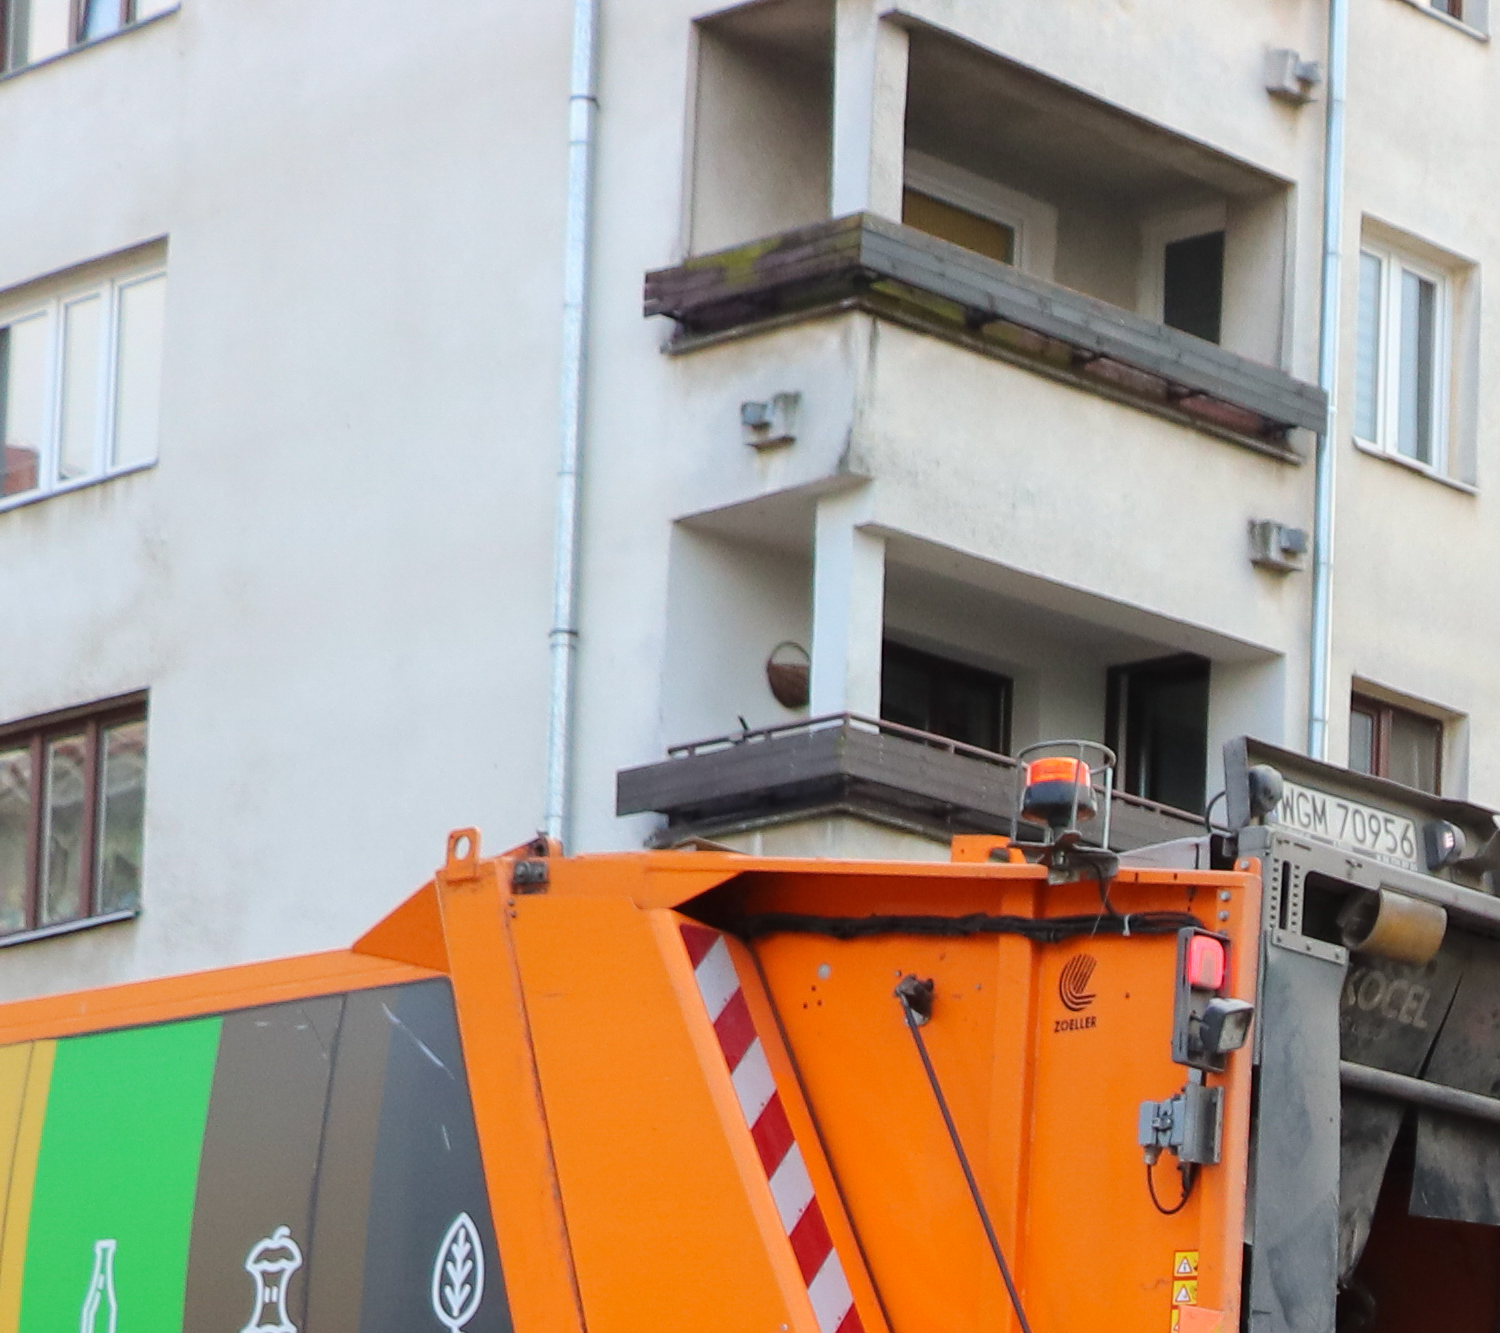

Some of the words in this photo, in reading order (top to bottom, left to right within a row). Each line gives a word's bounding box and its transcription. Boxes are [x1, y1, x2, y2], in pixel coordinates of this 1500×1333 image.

[1281, 790, 1328, 836] WGM
[1337, 803, 1414, 859] 70956
[1054, 1016, 1097, 1033] ZOELLER
